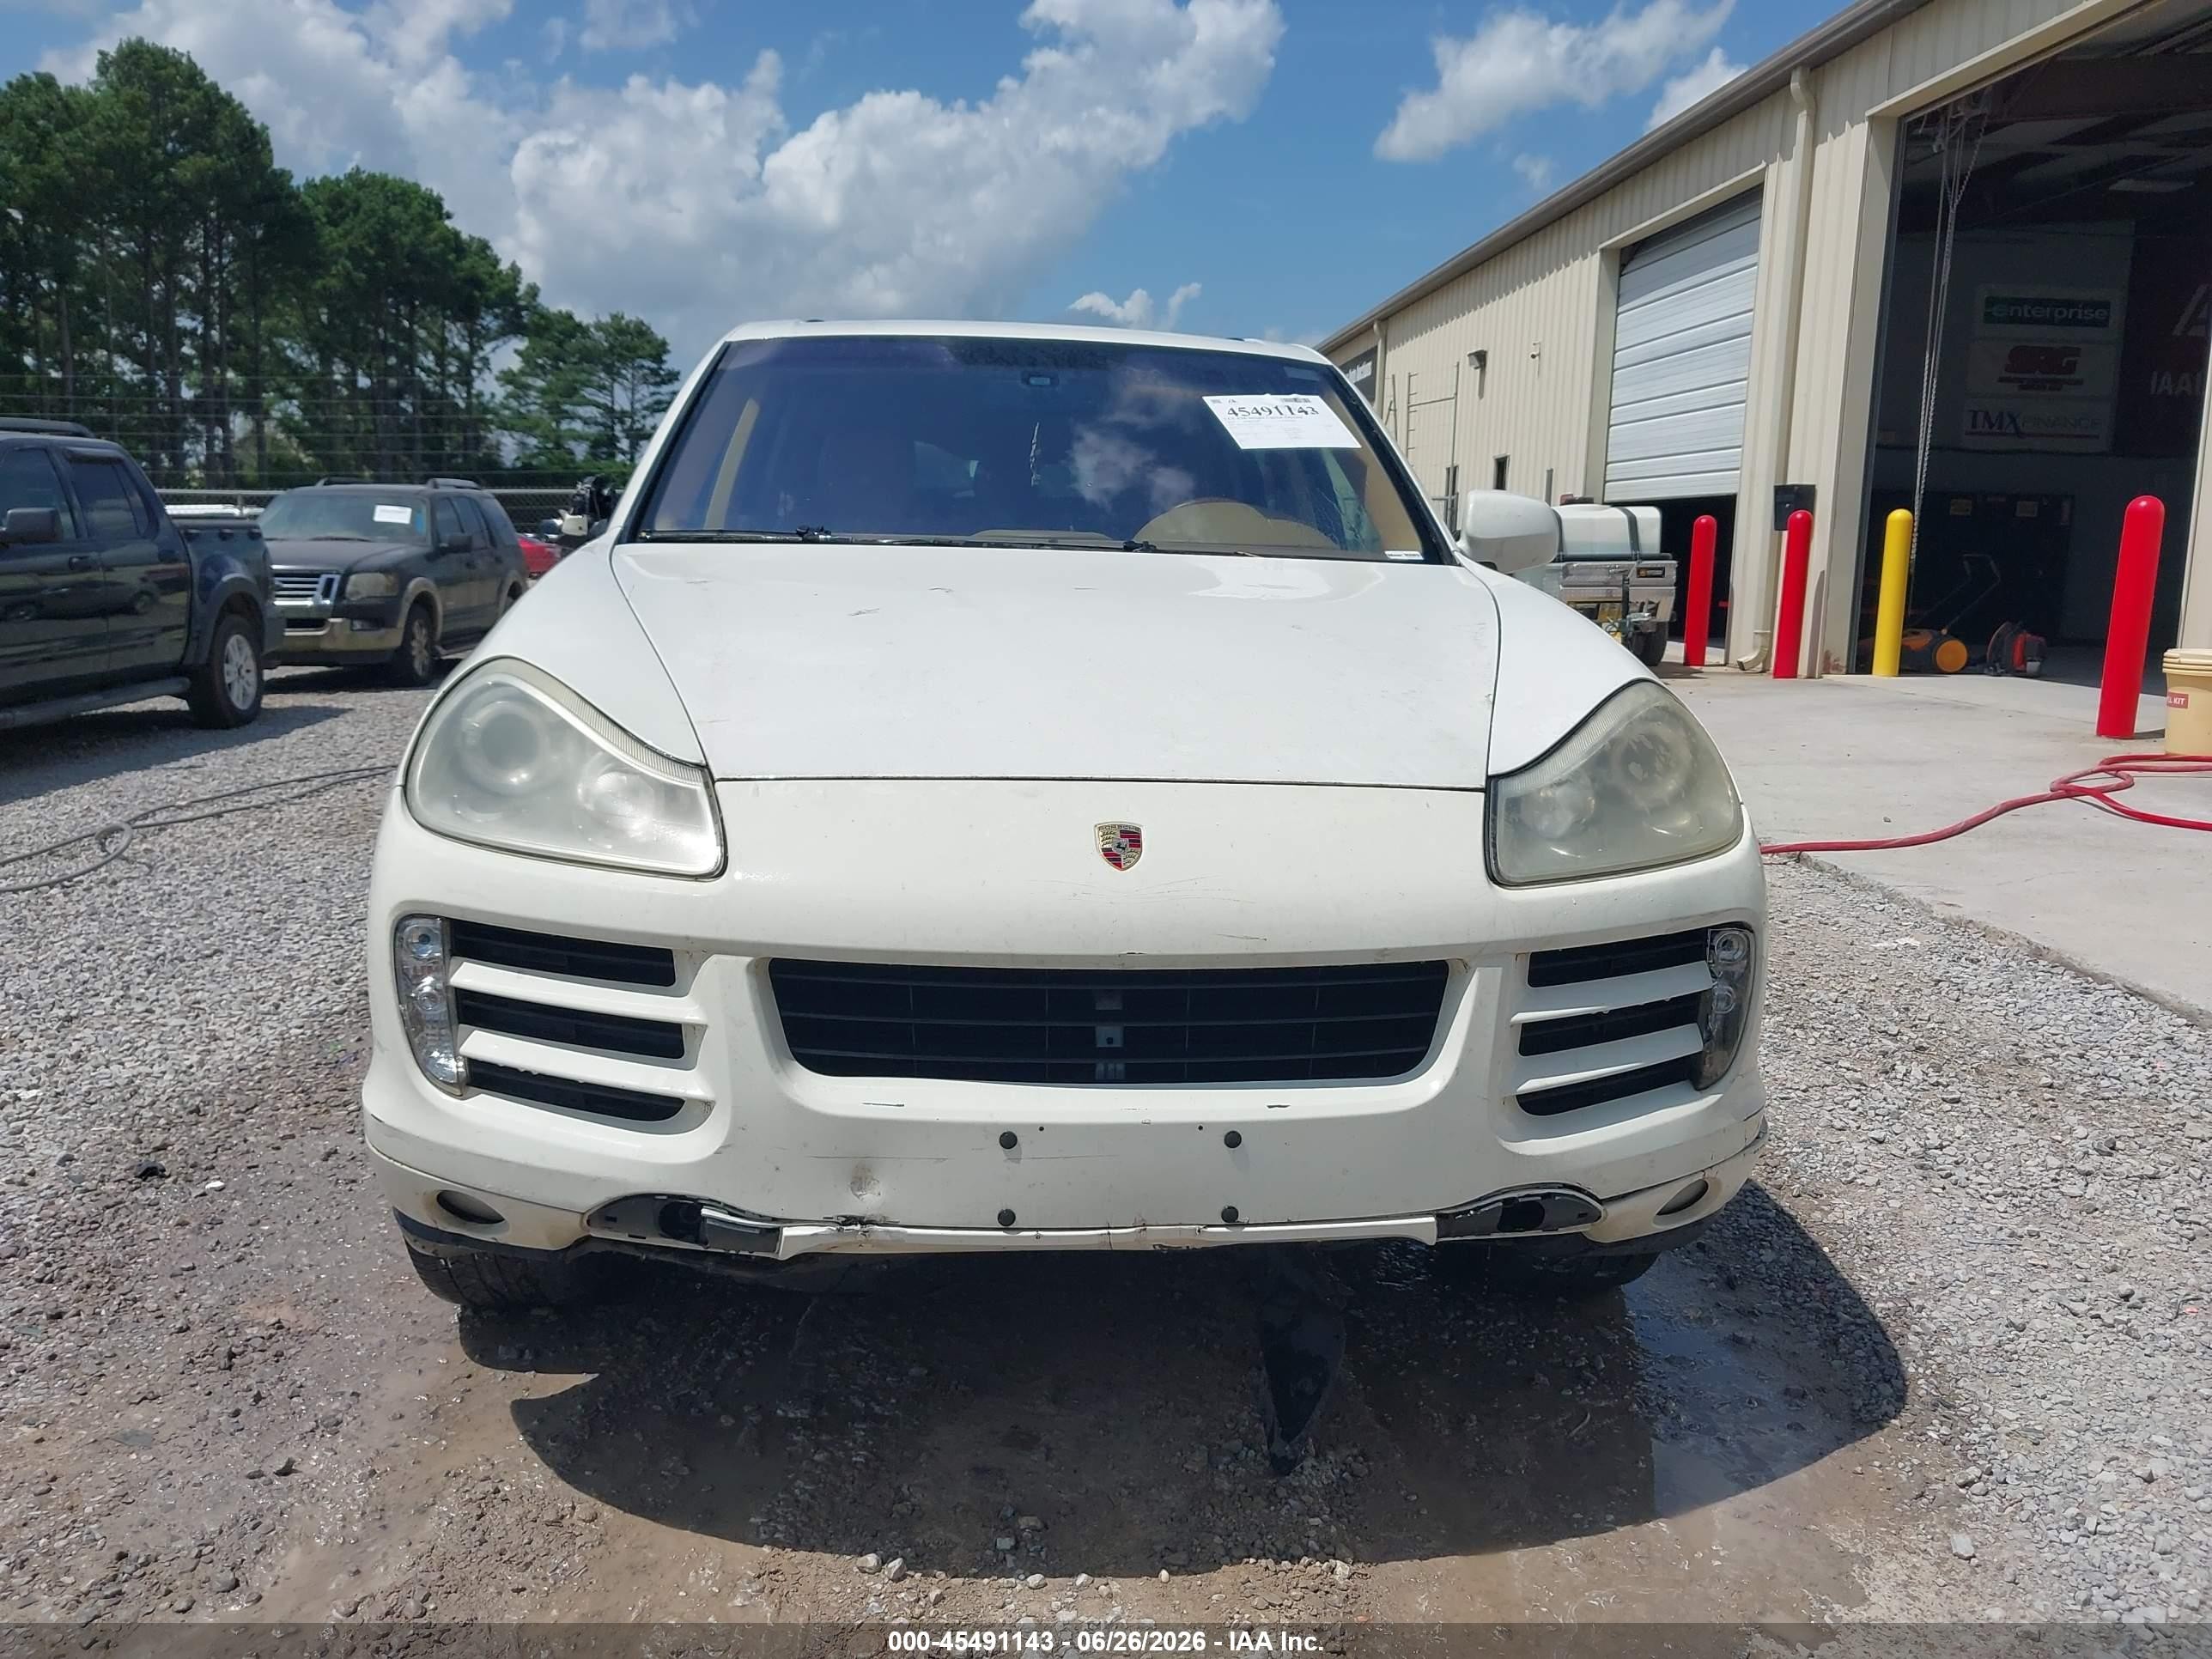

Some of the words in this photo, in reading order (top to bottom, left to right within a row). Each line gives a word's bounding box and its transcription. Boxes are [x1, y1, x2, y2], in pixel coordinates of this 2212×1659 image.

[1991, 303, 2109, 323] enterprise
[1226, 404, 1320, 417] 45491143
[1969, 410, 2024, 438] TMX
